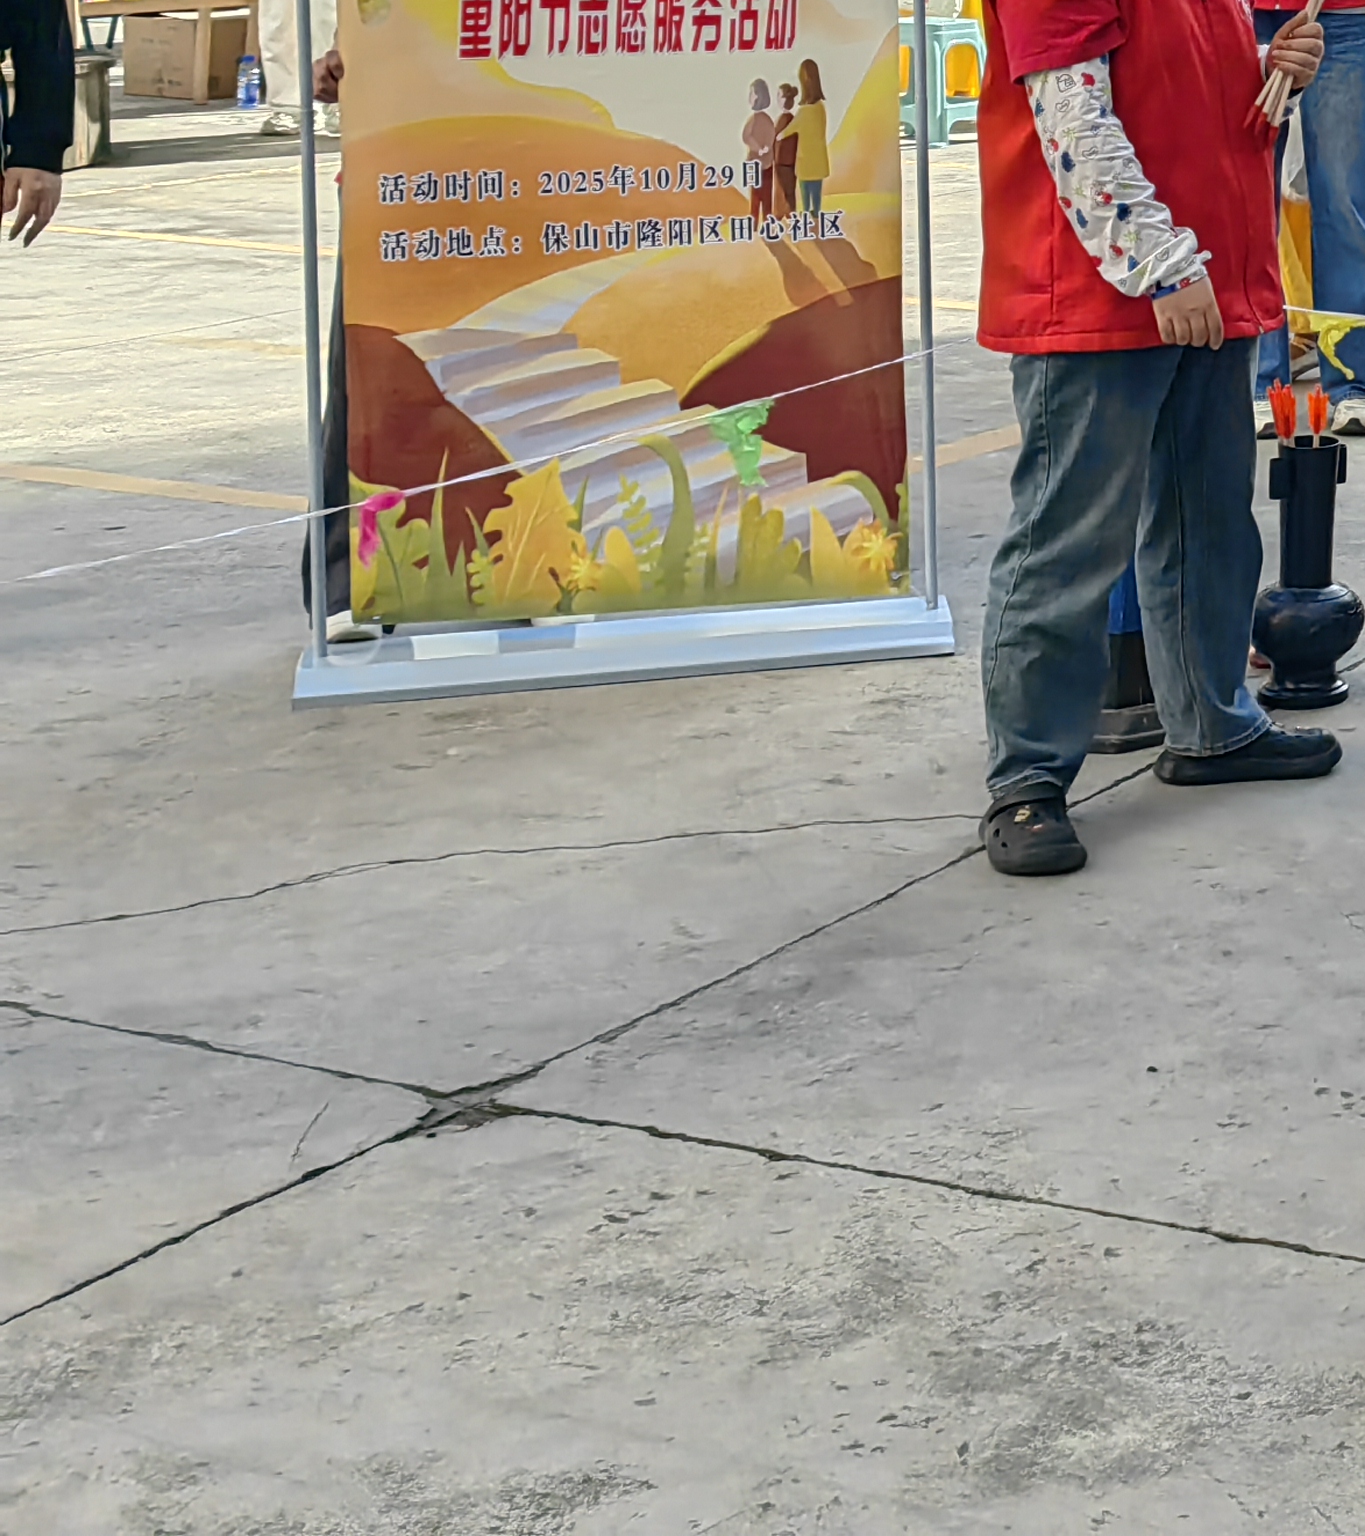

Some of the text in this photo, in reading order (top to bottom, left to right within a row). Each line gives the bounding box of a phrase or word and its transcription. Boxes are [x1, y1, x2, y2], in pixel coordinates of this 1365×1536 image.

[379, 160, 763, 205] 活动时间：2025年10月29日
[380, 210, 845, 261] 活动地点：保山市隆阳区田心社区
